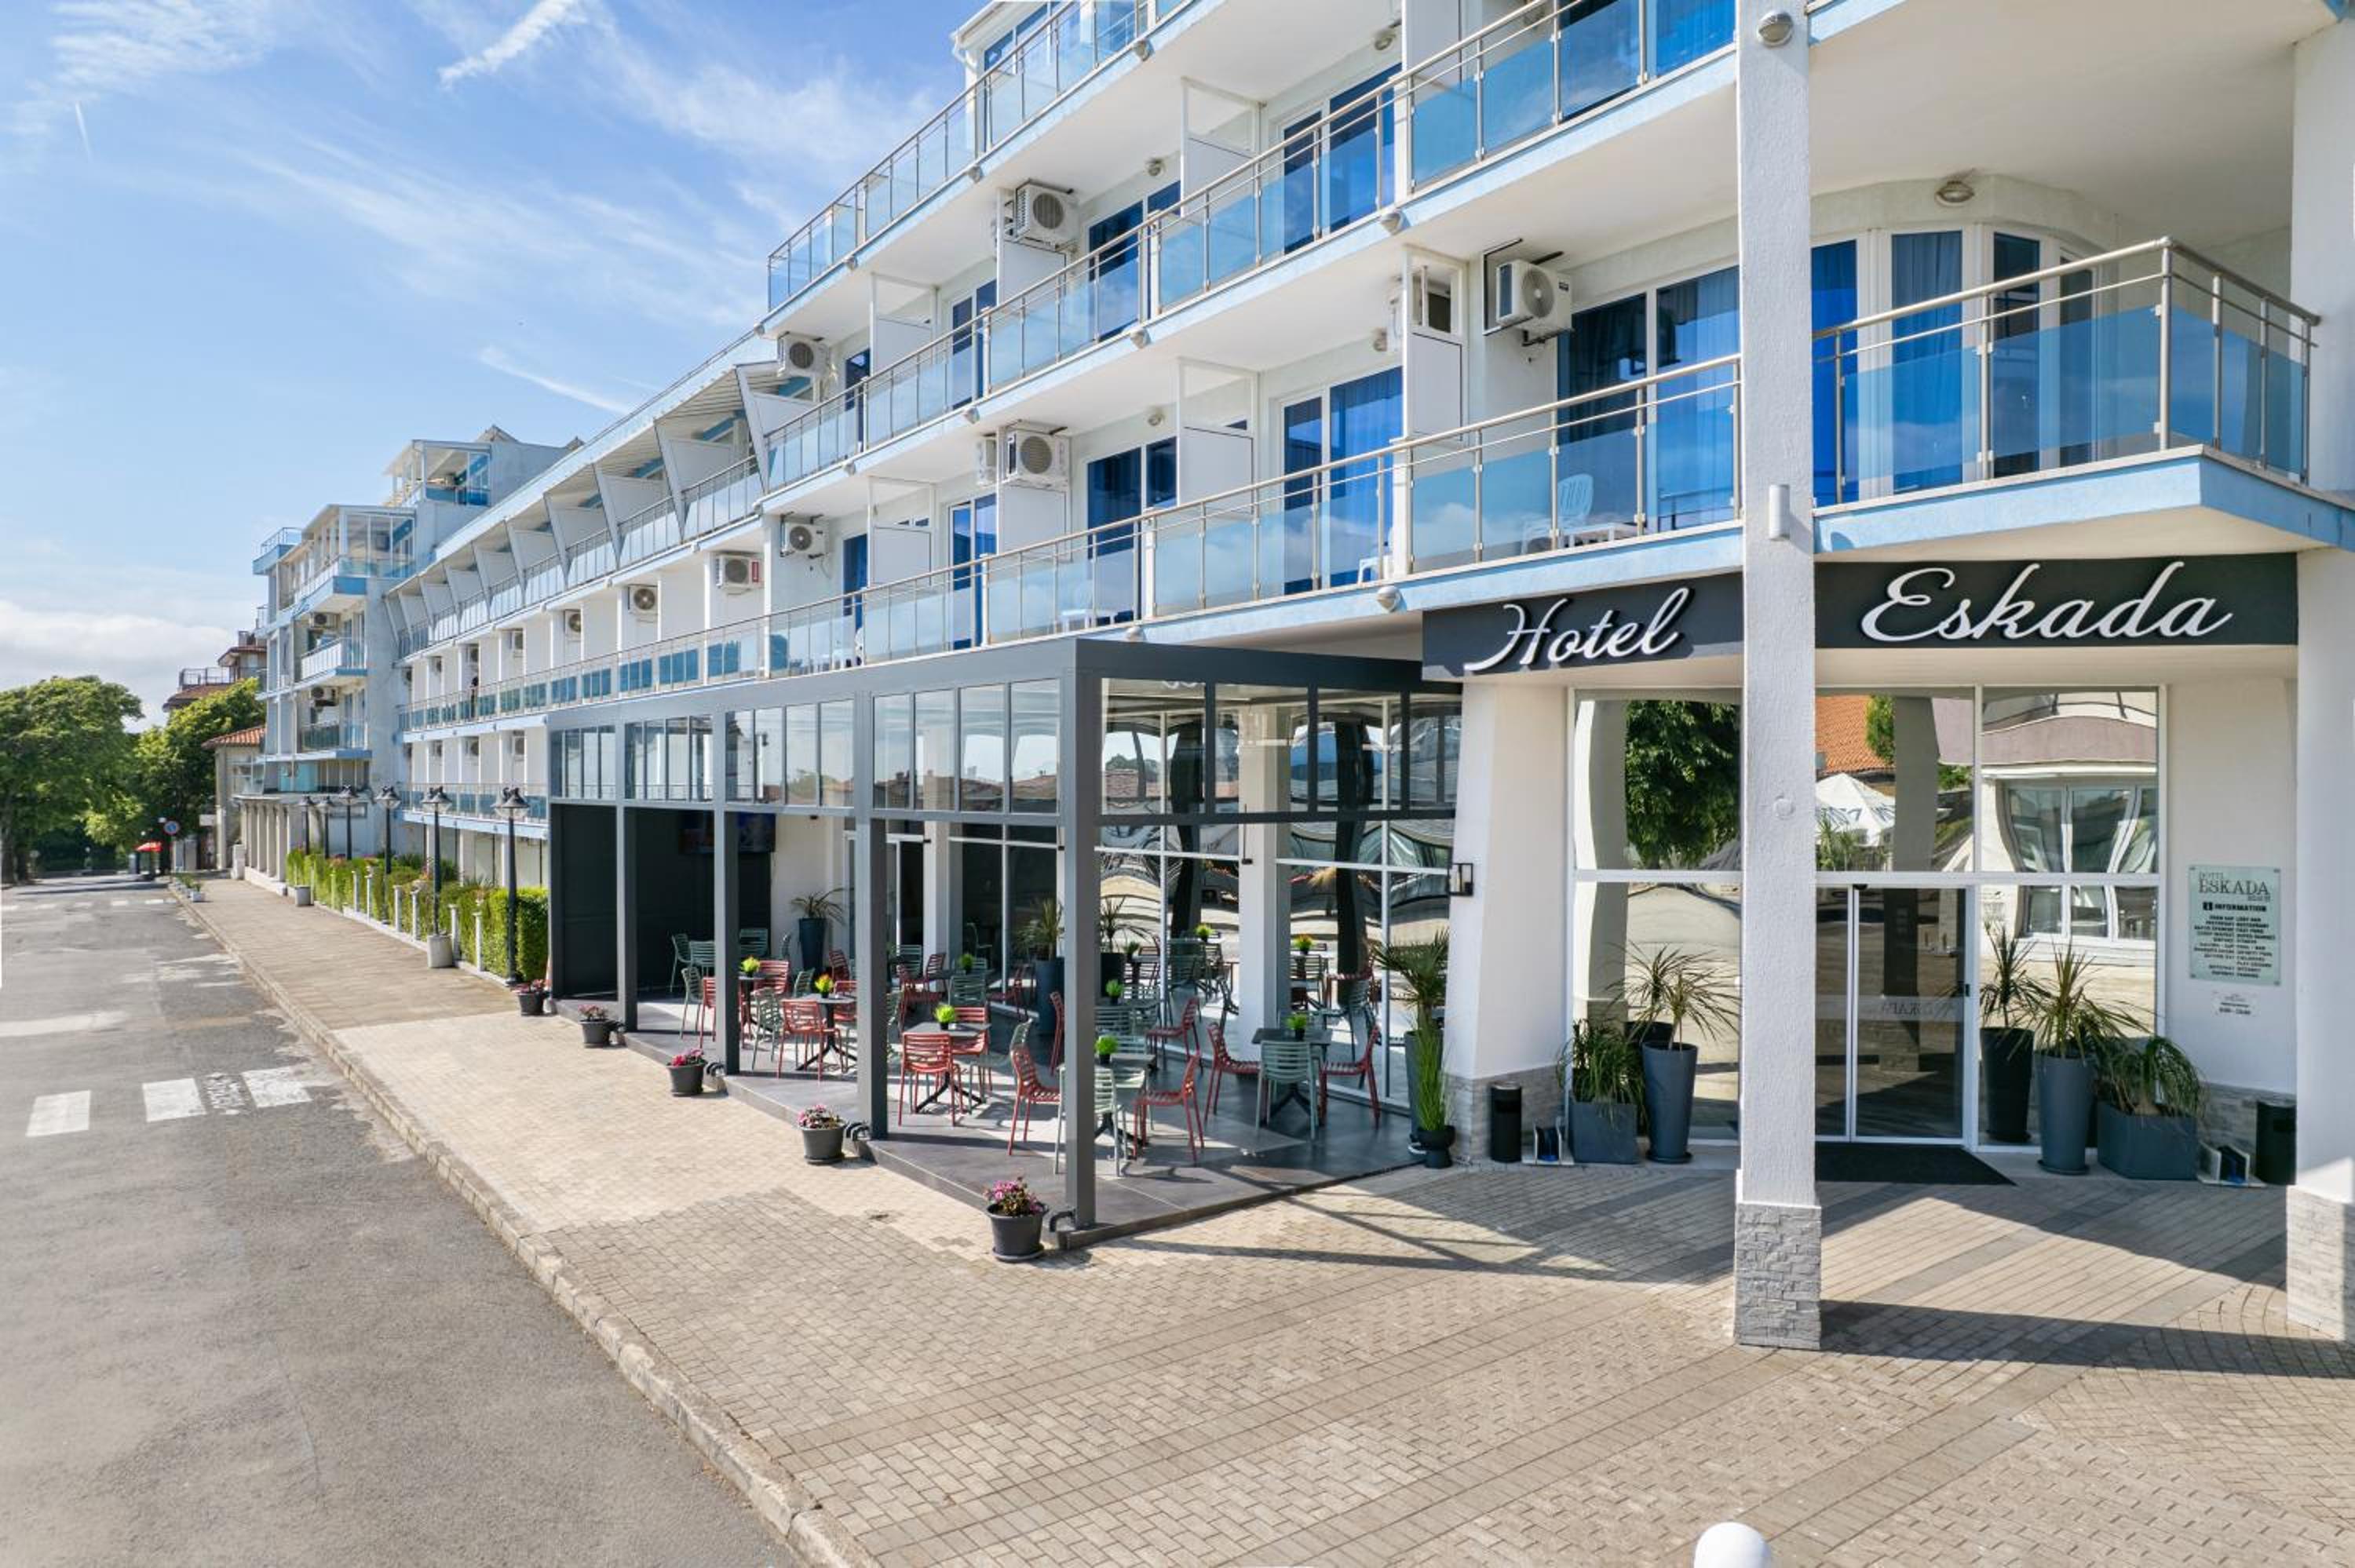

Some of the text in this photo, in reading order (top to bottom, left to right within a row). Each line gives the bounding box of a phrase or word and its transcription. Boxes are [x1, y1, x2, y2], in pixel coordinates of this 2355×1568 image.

[1463, 561, 2233, 672] Hotel Eskada
[2199, 879, 2270, 895] ESKADA
